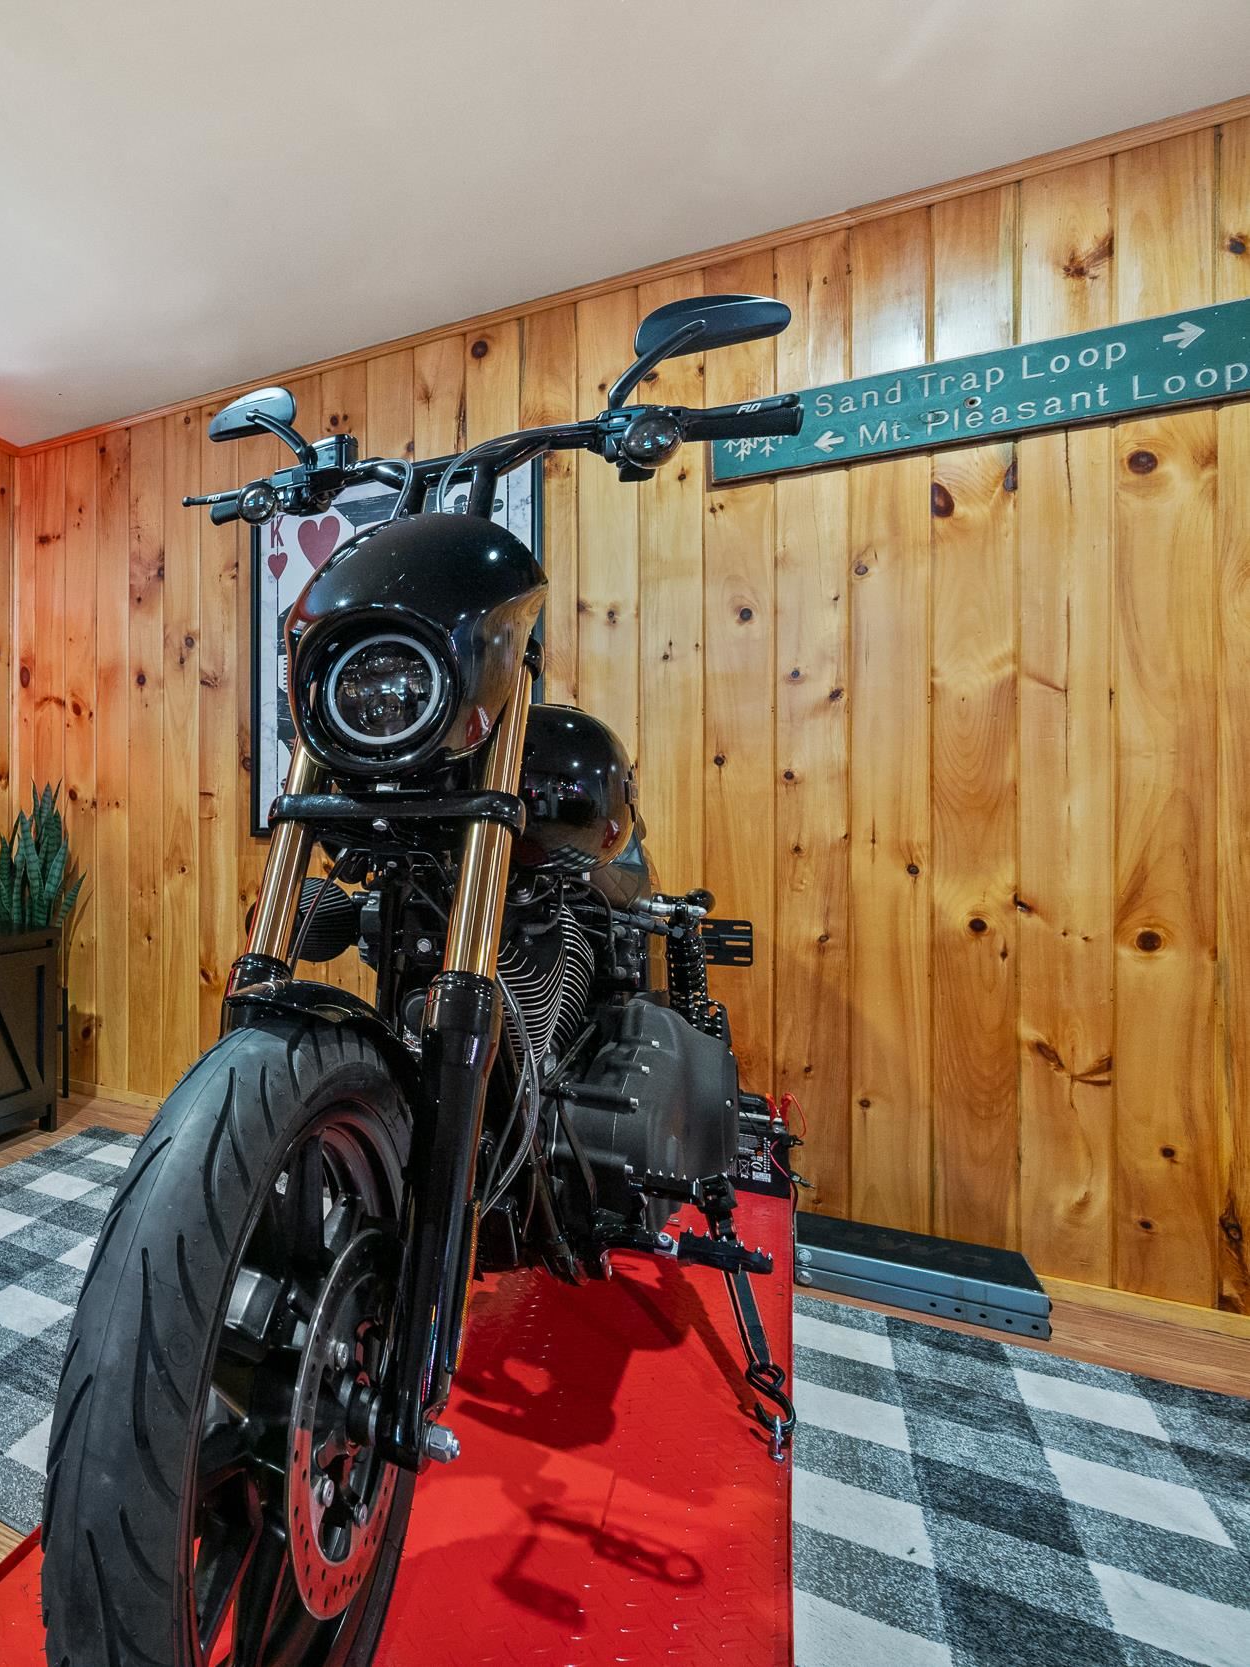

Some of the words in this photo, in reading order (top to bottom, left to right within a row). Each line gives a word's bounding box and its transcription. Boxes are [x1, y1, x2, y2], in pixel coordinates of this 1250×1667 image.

[815, 379, 902, 417] Sand
[917, 366, 1006, 398] Trap
[1021, 341, 1128, 380] Loop
[859, 420, 911, 448] Mt.
[926, 383, 1110, 437] Pleasant
[1132, 362, 1249, 401] Loop
[736, 402, 762, 415] FLO
[270, 515, 285, 548] K
